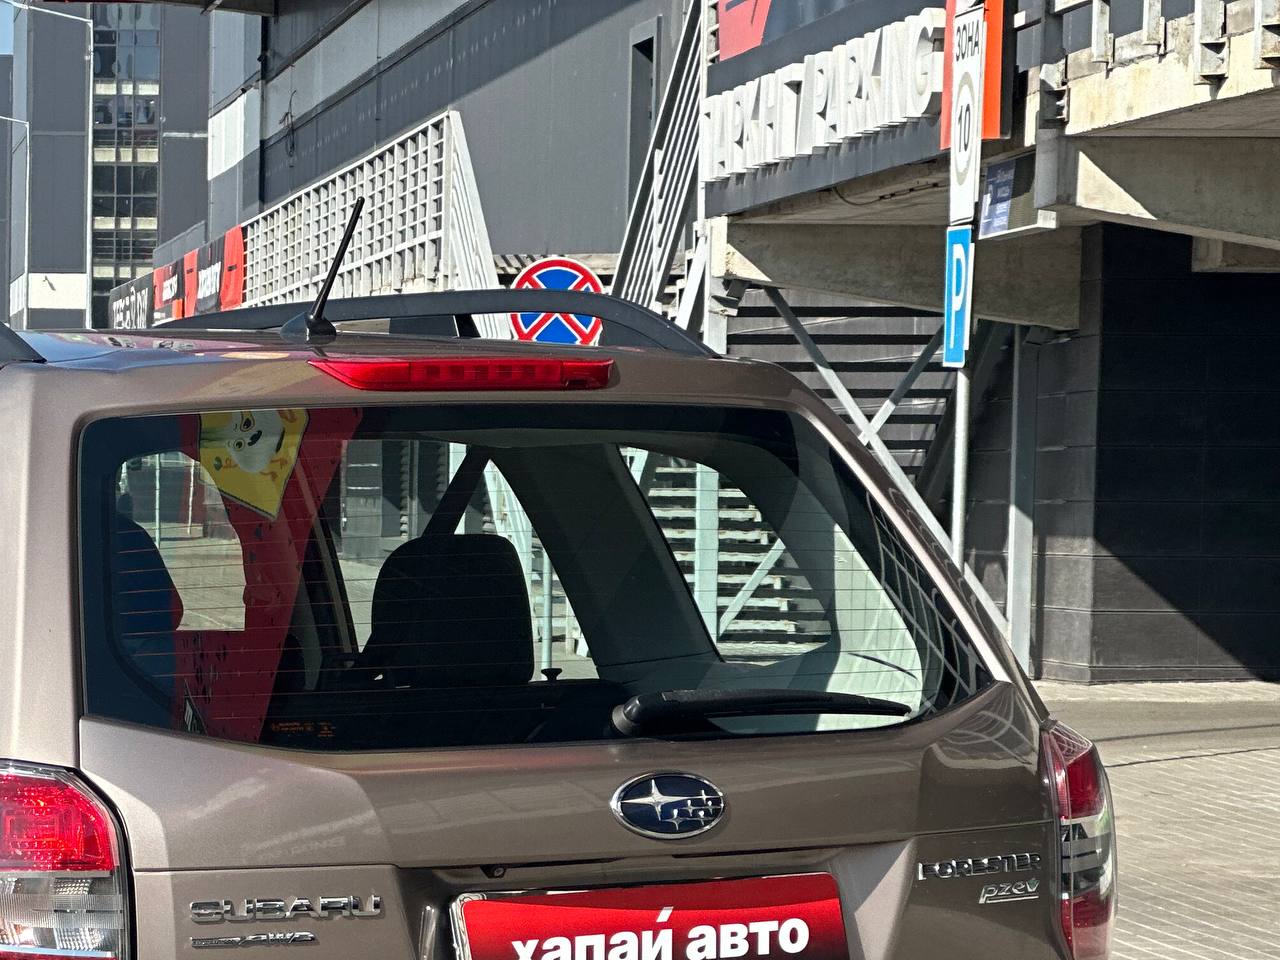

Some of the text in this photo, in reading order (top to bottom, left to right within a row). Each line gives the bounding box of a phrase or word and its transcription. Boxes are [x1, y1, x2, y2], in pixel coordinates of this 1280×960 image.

[955, 20, 980, 61] ЗОНА
[958, 103, 971, 152] 10
[950, 243, 966, 349] P
[918, 852, 1041, 880] FORESTER
[190, 895, 382, 924] SUBARU
